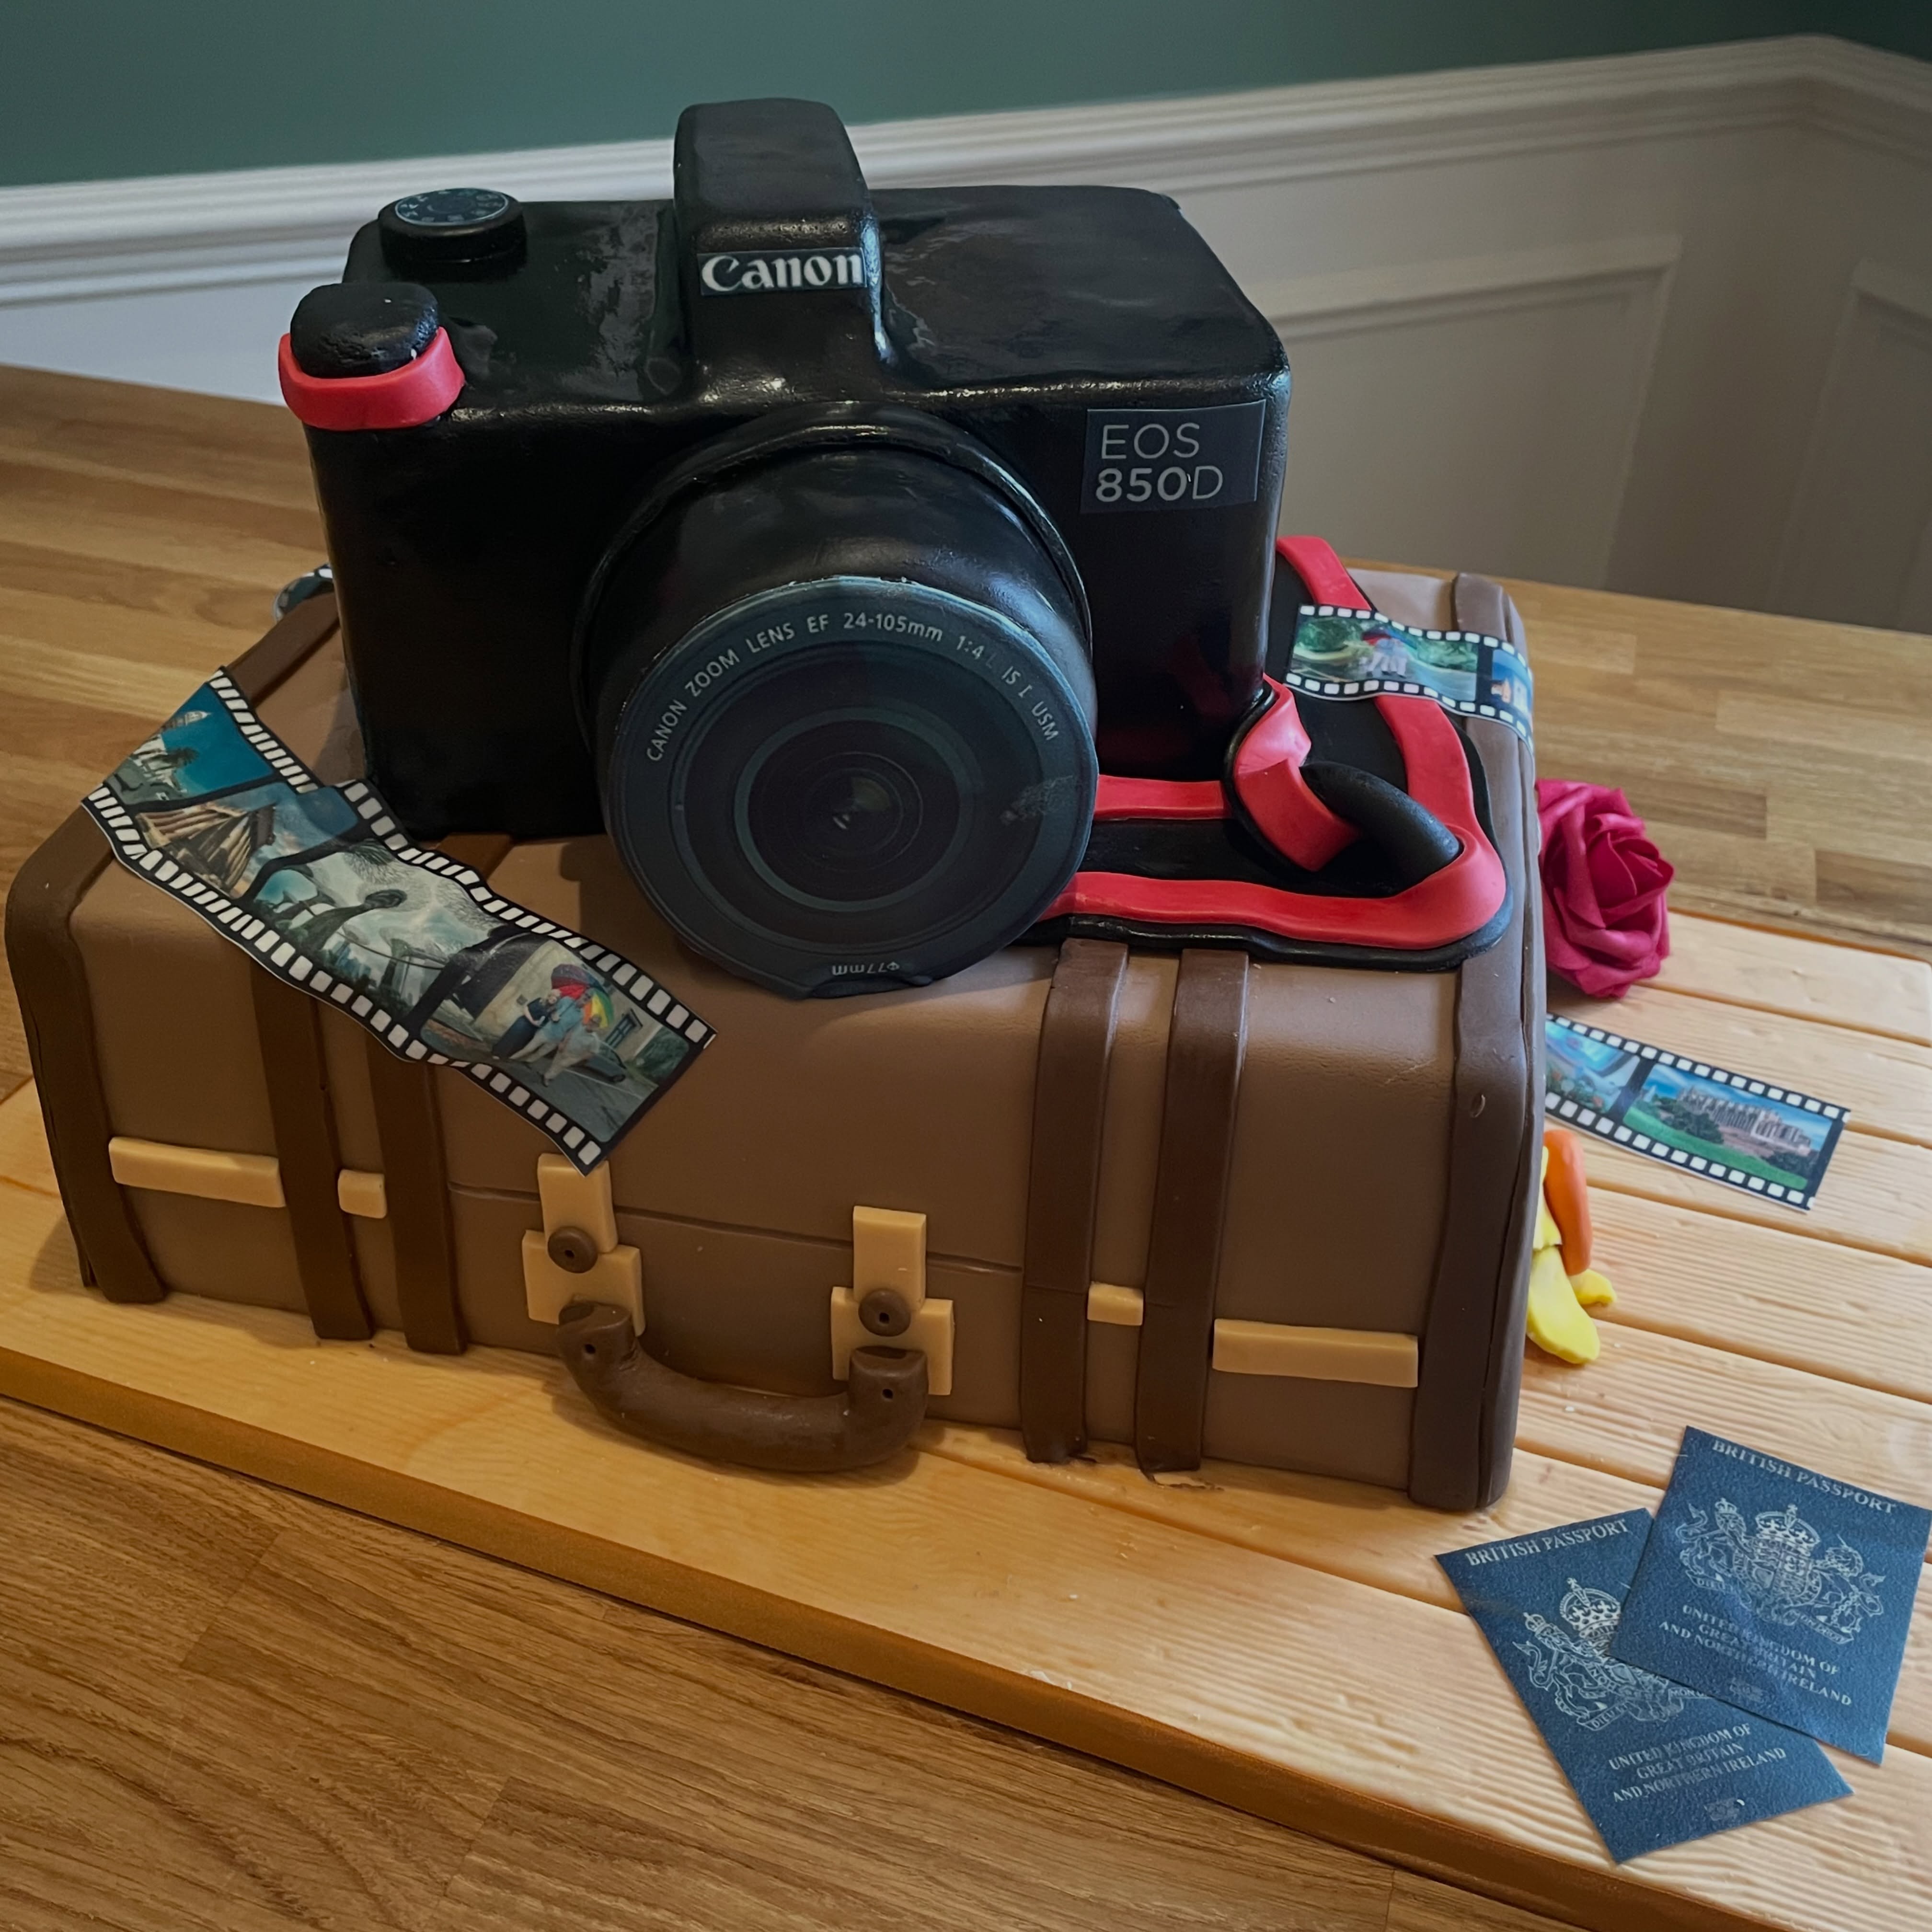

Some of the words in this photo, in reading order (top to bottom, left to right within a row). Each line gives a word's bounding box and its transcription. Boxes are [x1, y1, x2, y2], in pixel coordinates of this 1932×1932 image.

[702, 254, 863, 291] Canon
[1102, 423, 1199, 459] EOS
[1096, 465, 1223, 502] 850D
[646, 699, 688, 761] CANON
[685, 649, 740, 697] ZOOM
[745, 623, 795, 653] LENS
[806, 614, 828, 633] EF
[843, 612, 943, 642] 24-105mm
[1001, 666, 1021, 685] IS
[1032, 702, 1058, 740] USM
[1712, 1439, 1791, 1478] BRITISH
[1796, 1471, 1896, 1513] PASSPORT
[1465, 1540, 1541, 1565] BRITISH
[1541, 1518, 1629, 1550] PASSPORT
[1659, 1621, 1691, 1638] AND
[1819, 1660, 1840, 1675] OF
[1608, 1747, 1663, 1770] UNITED
[1663, 1728, 1732, 1756] KINGDOM
[1733, 1723, 1752, 1736] OF
[1613, 1785, 1643, 1802] AND
[1724, 1748, 1786, 1773] IRELAND
[1636, 1758, 1683, 1779] GREAT
